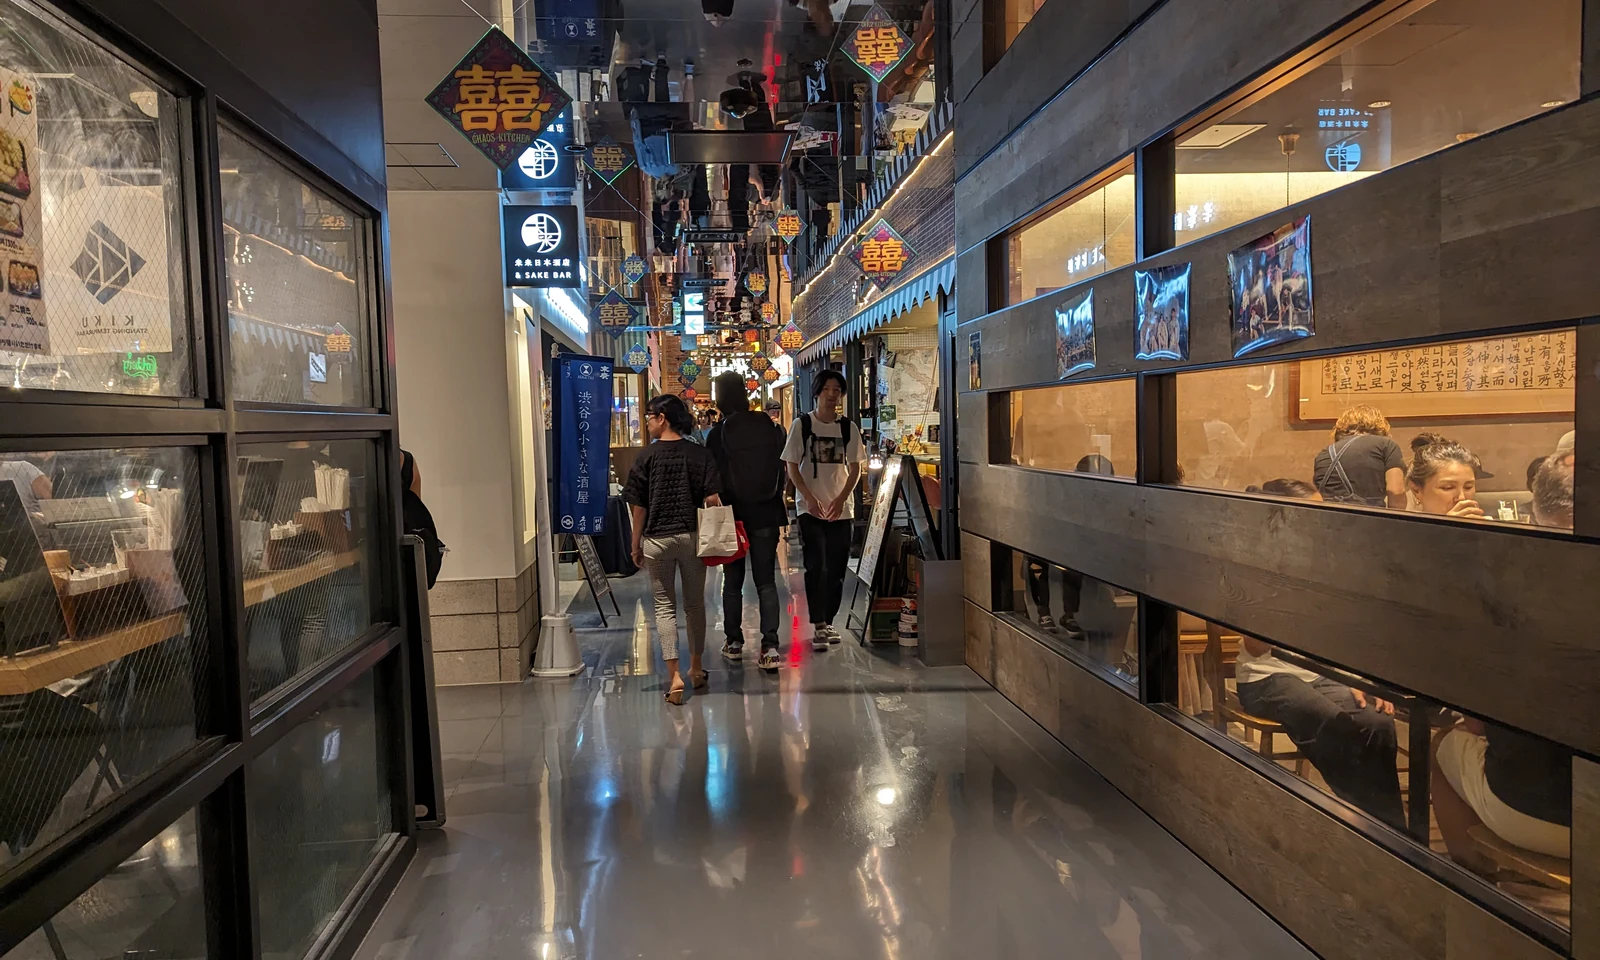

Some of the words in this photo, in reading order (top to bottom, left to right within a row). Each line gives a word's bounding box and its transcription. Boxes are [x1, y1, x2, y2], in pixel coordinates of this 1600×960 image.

[471, 133, 496, 144] CHAOS
[498, 132, 531, 144] KITCHEN
[525, 271, 549, 279] SAKE
[552, 271, 572, 279] BAR
[576, 390, 592, 504] 渋谷の小さな酒屋
